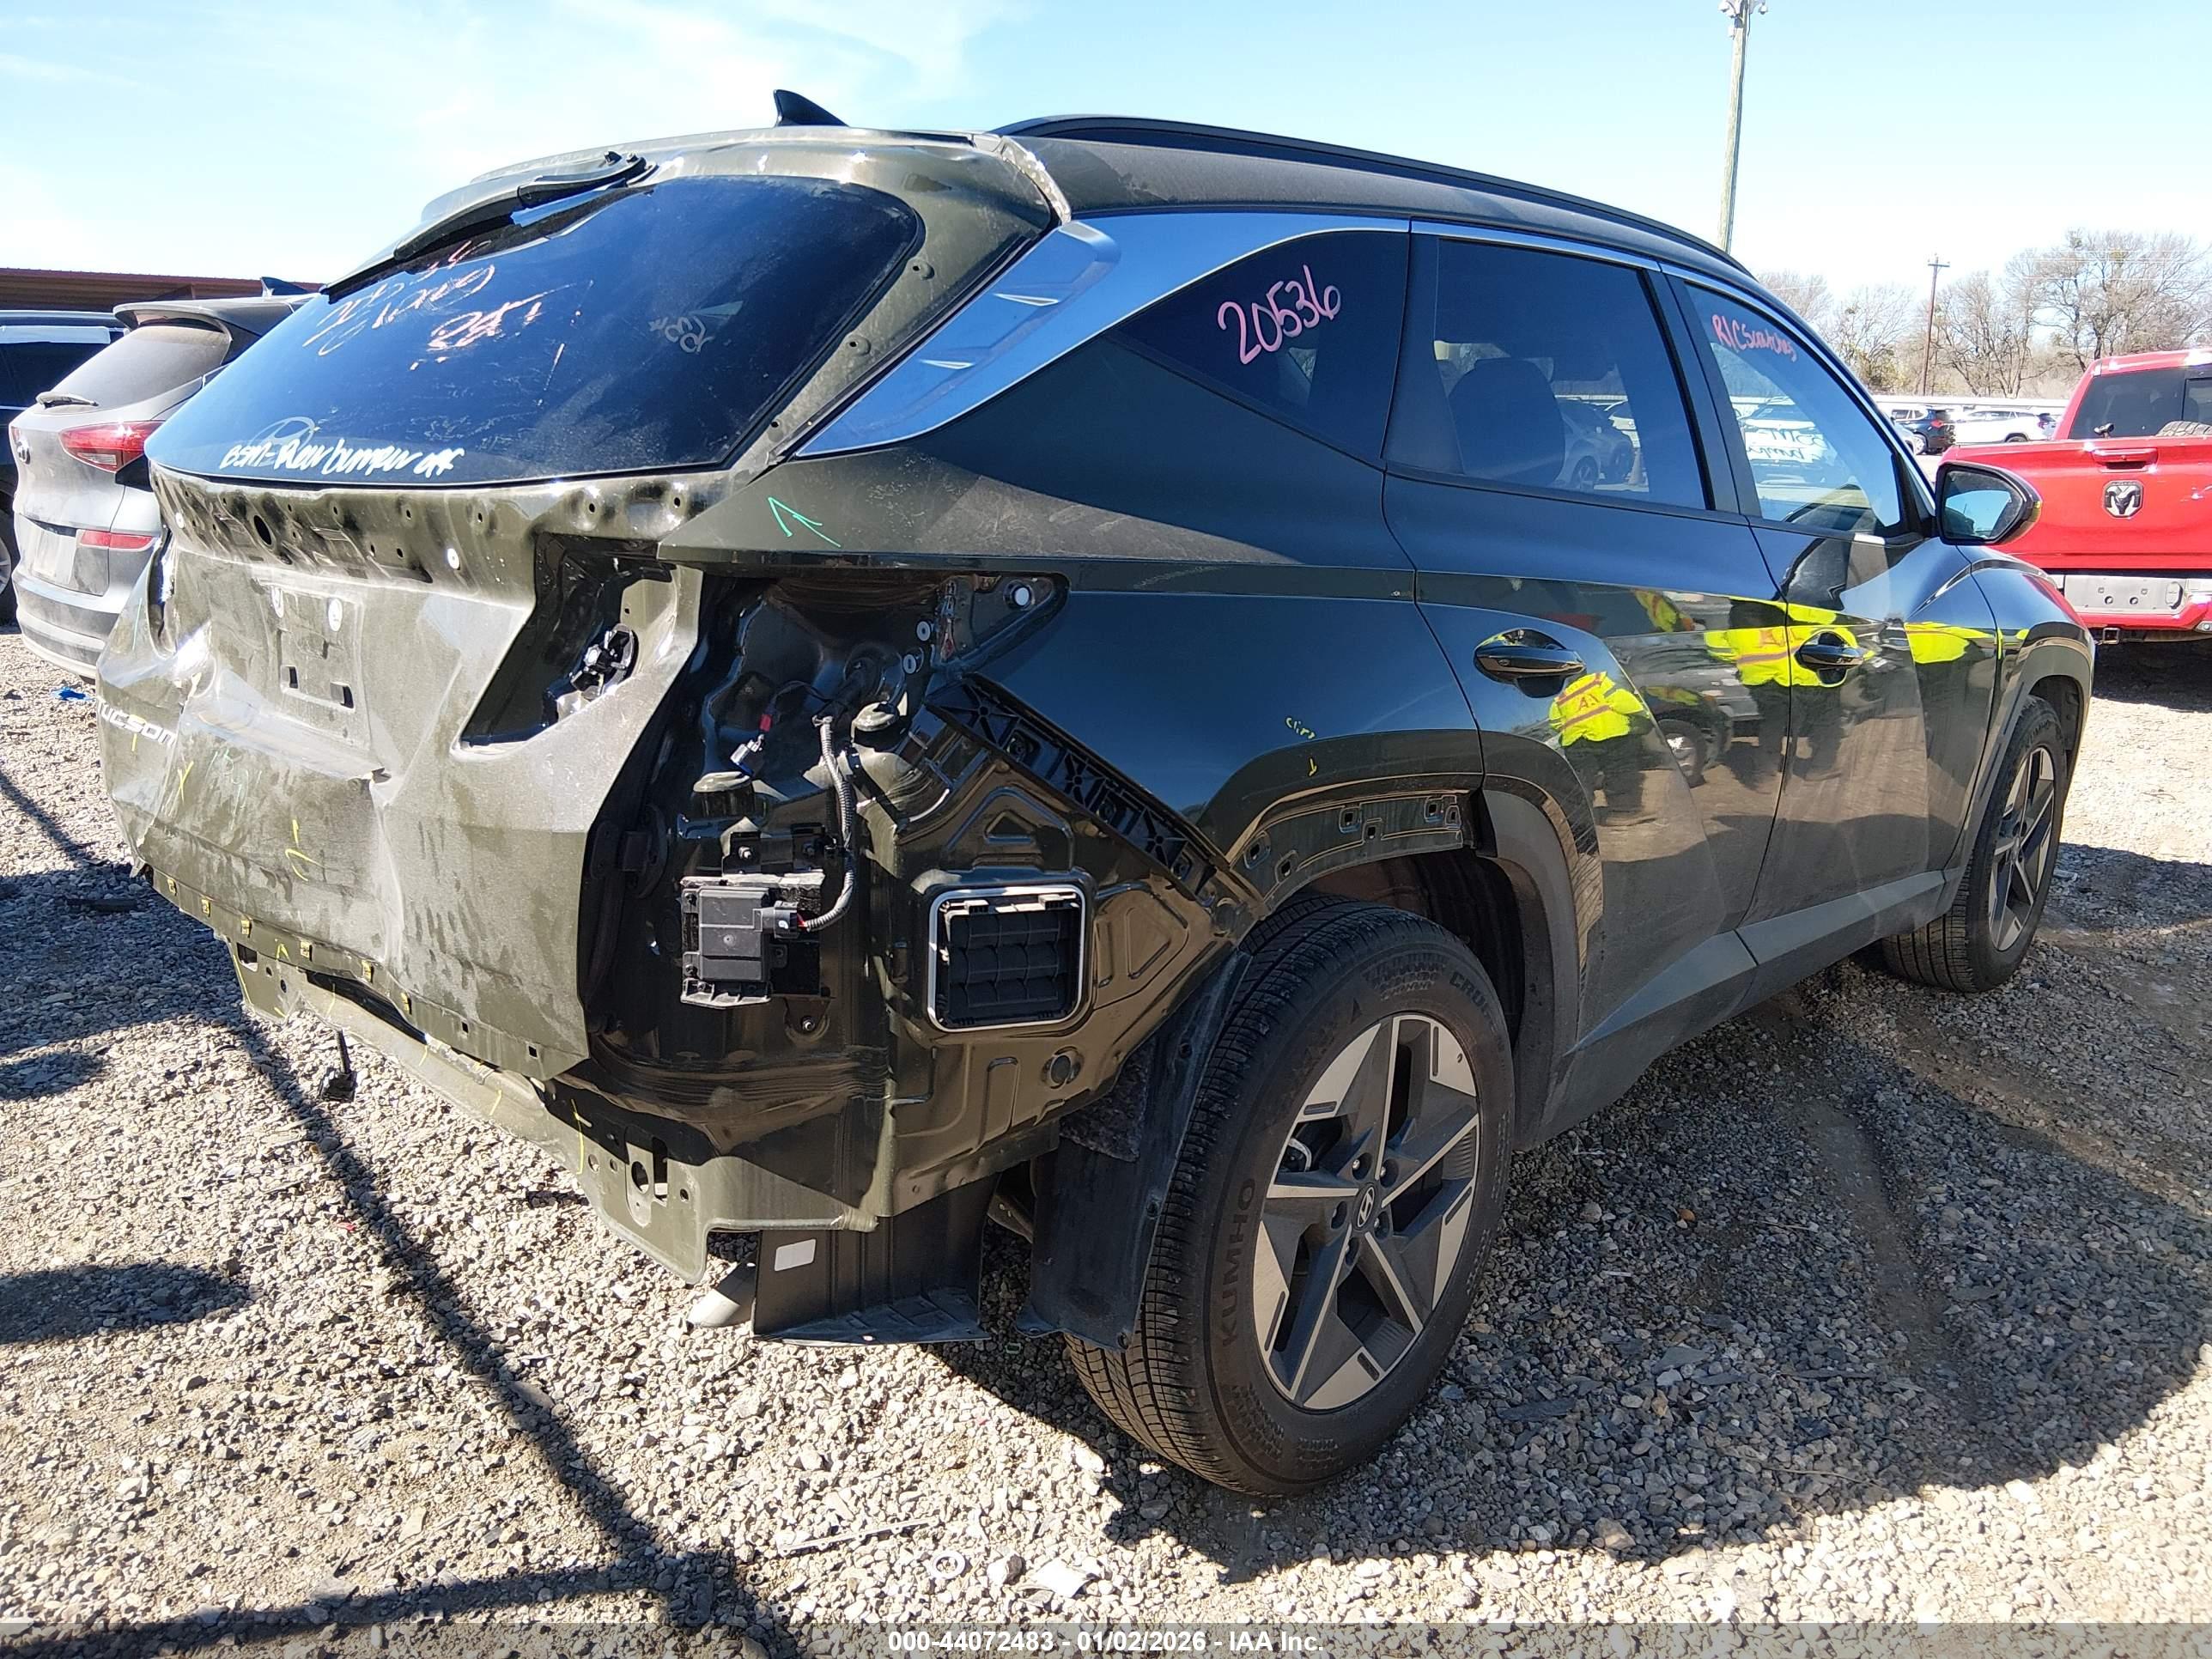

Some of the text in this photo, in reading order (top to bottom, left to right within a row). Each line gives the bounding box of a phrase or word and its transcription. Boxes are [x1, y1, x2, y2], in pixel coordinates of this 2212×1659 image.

[1218, 264, 1341, 364] 20536
[96, 696, 177, 749] TUCSON
[1222, 1177, 1255, 1347] KUMHO
